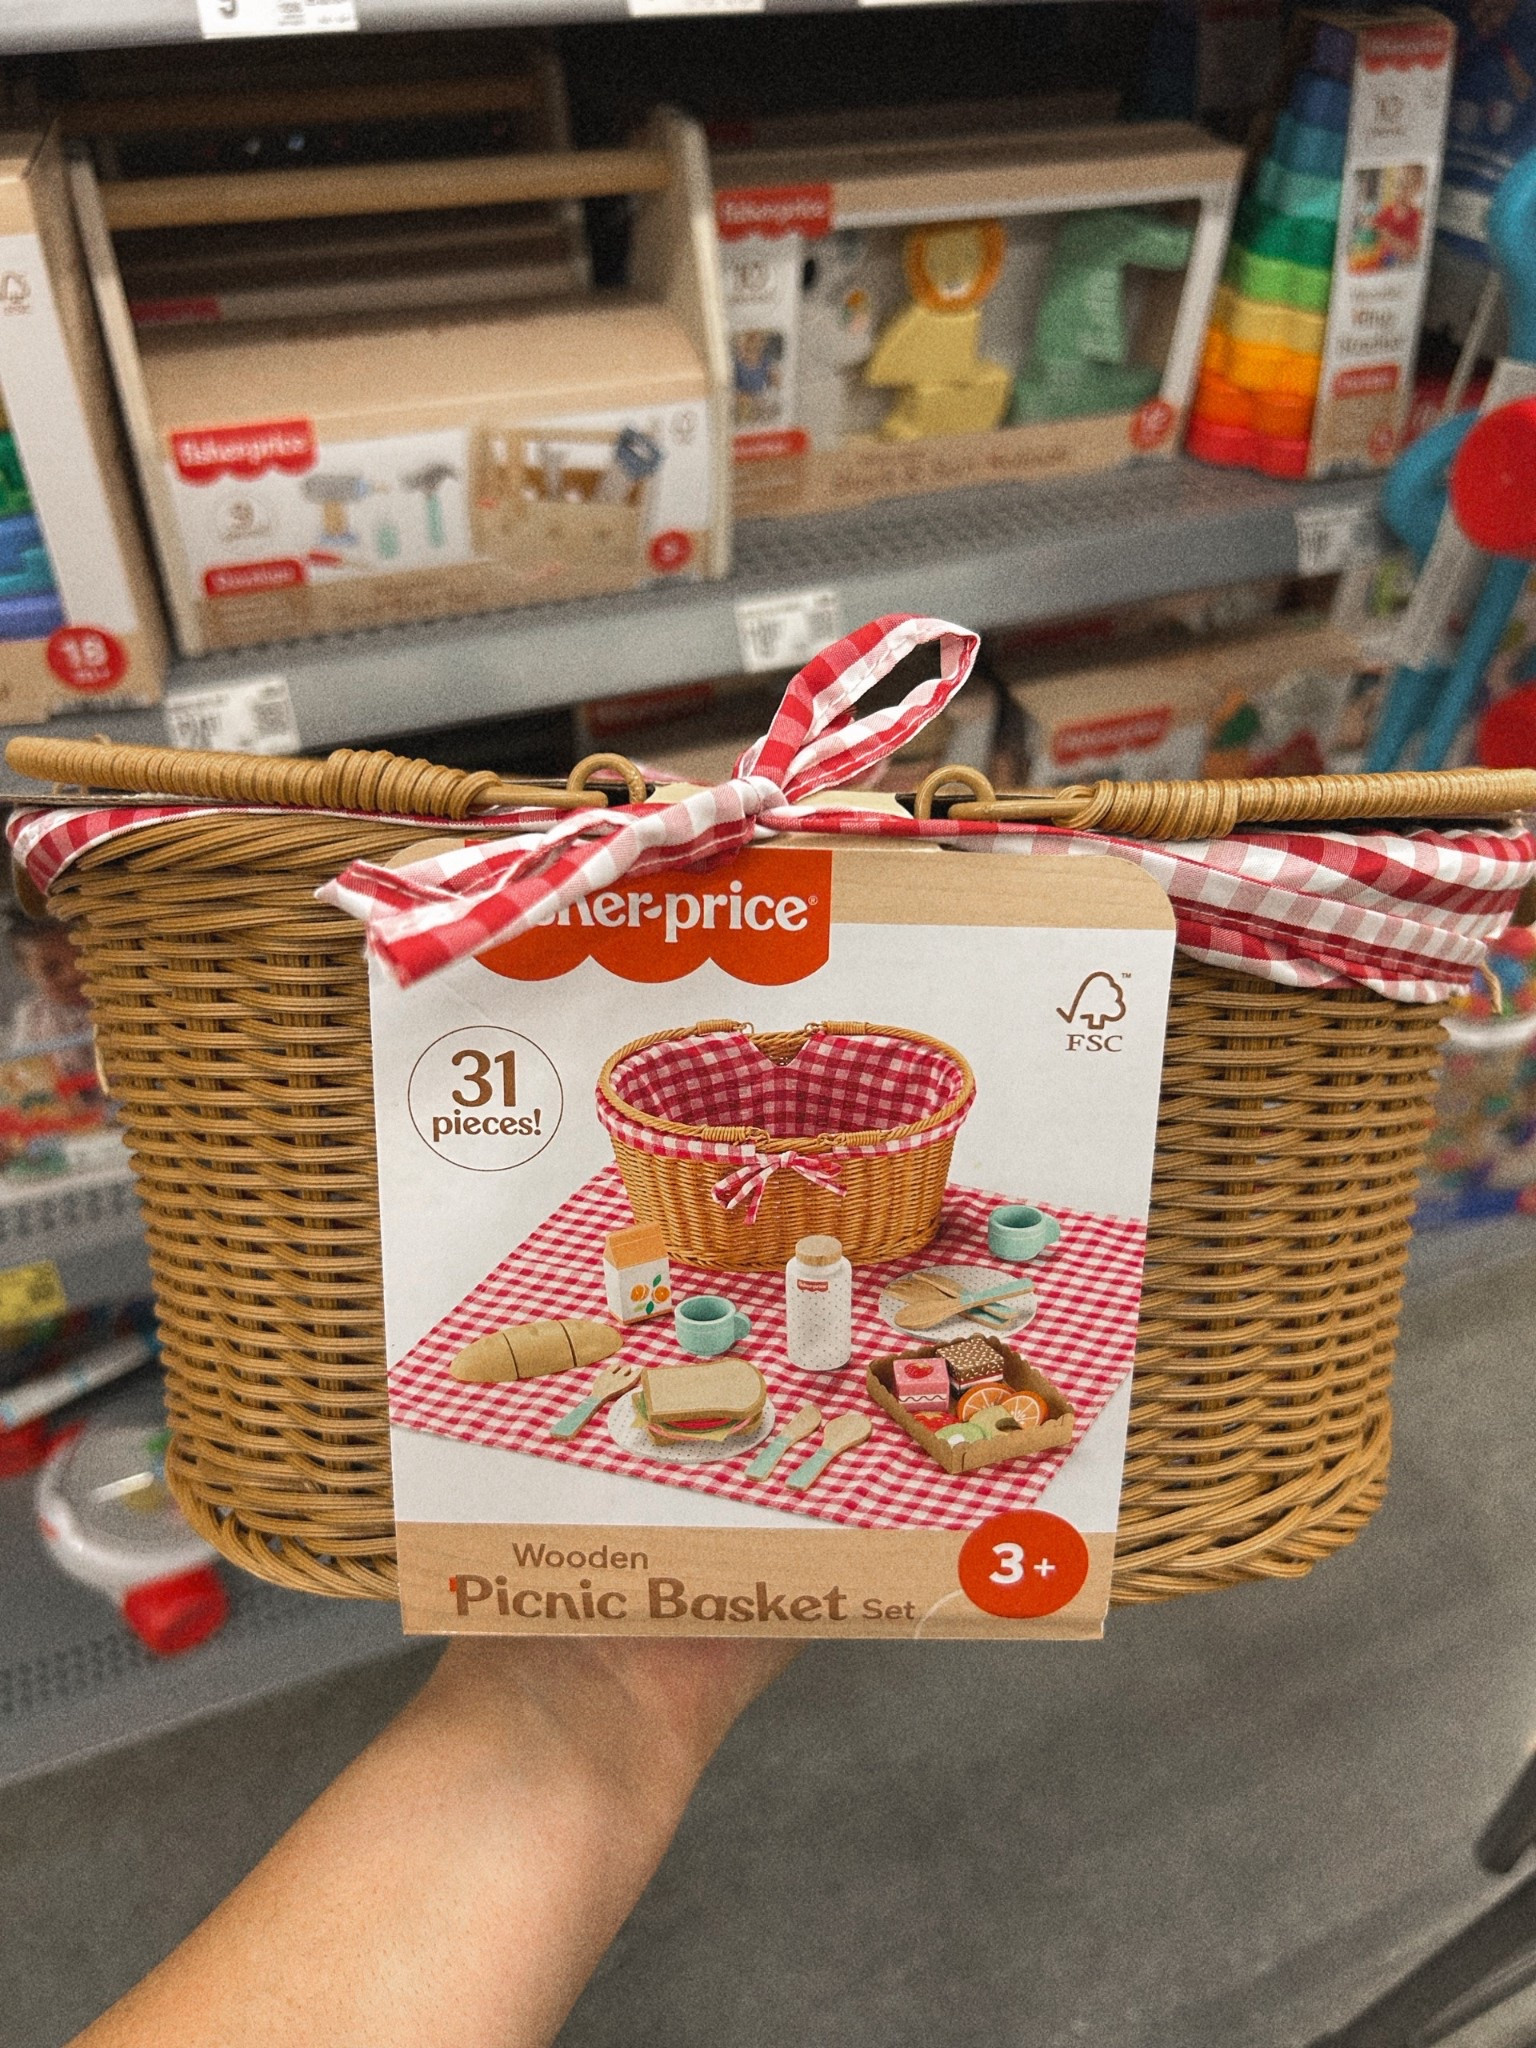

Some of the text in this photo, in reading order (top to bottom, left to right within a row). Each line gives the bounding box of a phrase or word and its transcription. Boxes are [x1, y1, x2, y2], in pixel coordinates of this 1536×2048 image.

[1065, 1033, 1123, 1053] FSC
[451, 1049, 517, 1108] 31
[432, 1108, 542, 1142] pieces!
[512, 1542, 649, 1570] Wooden
[455, 1574, 917, 1623] Picnic Basket Set
